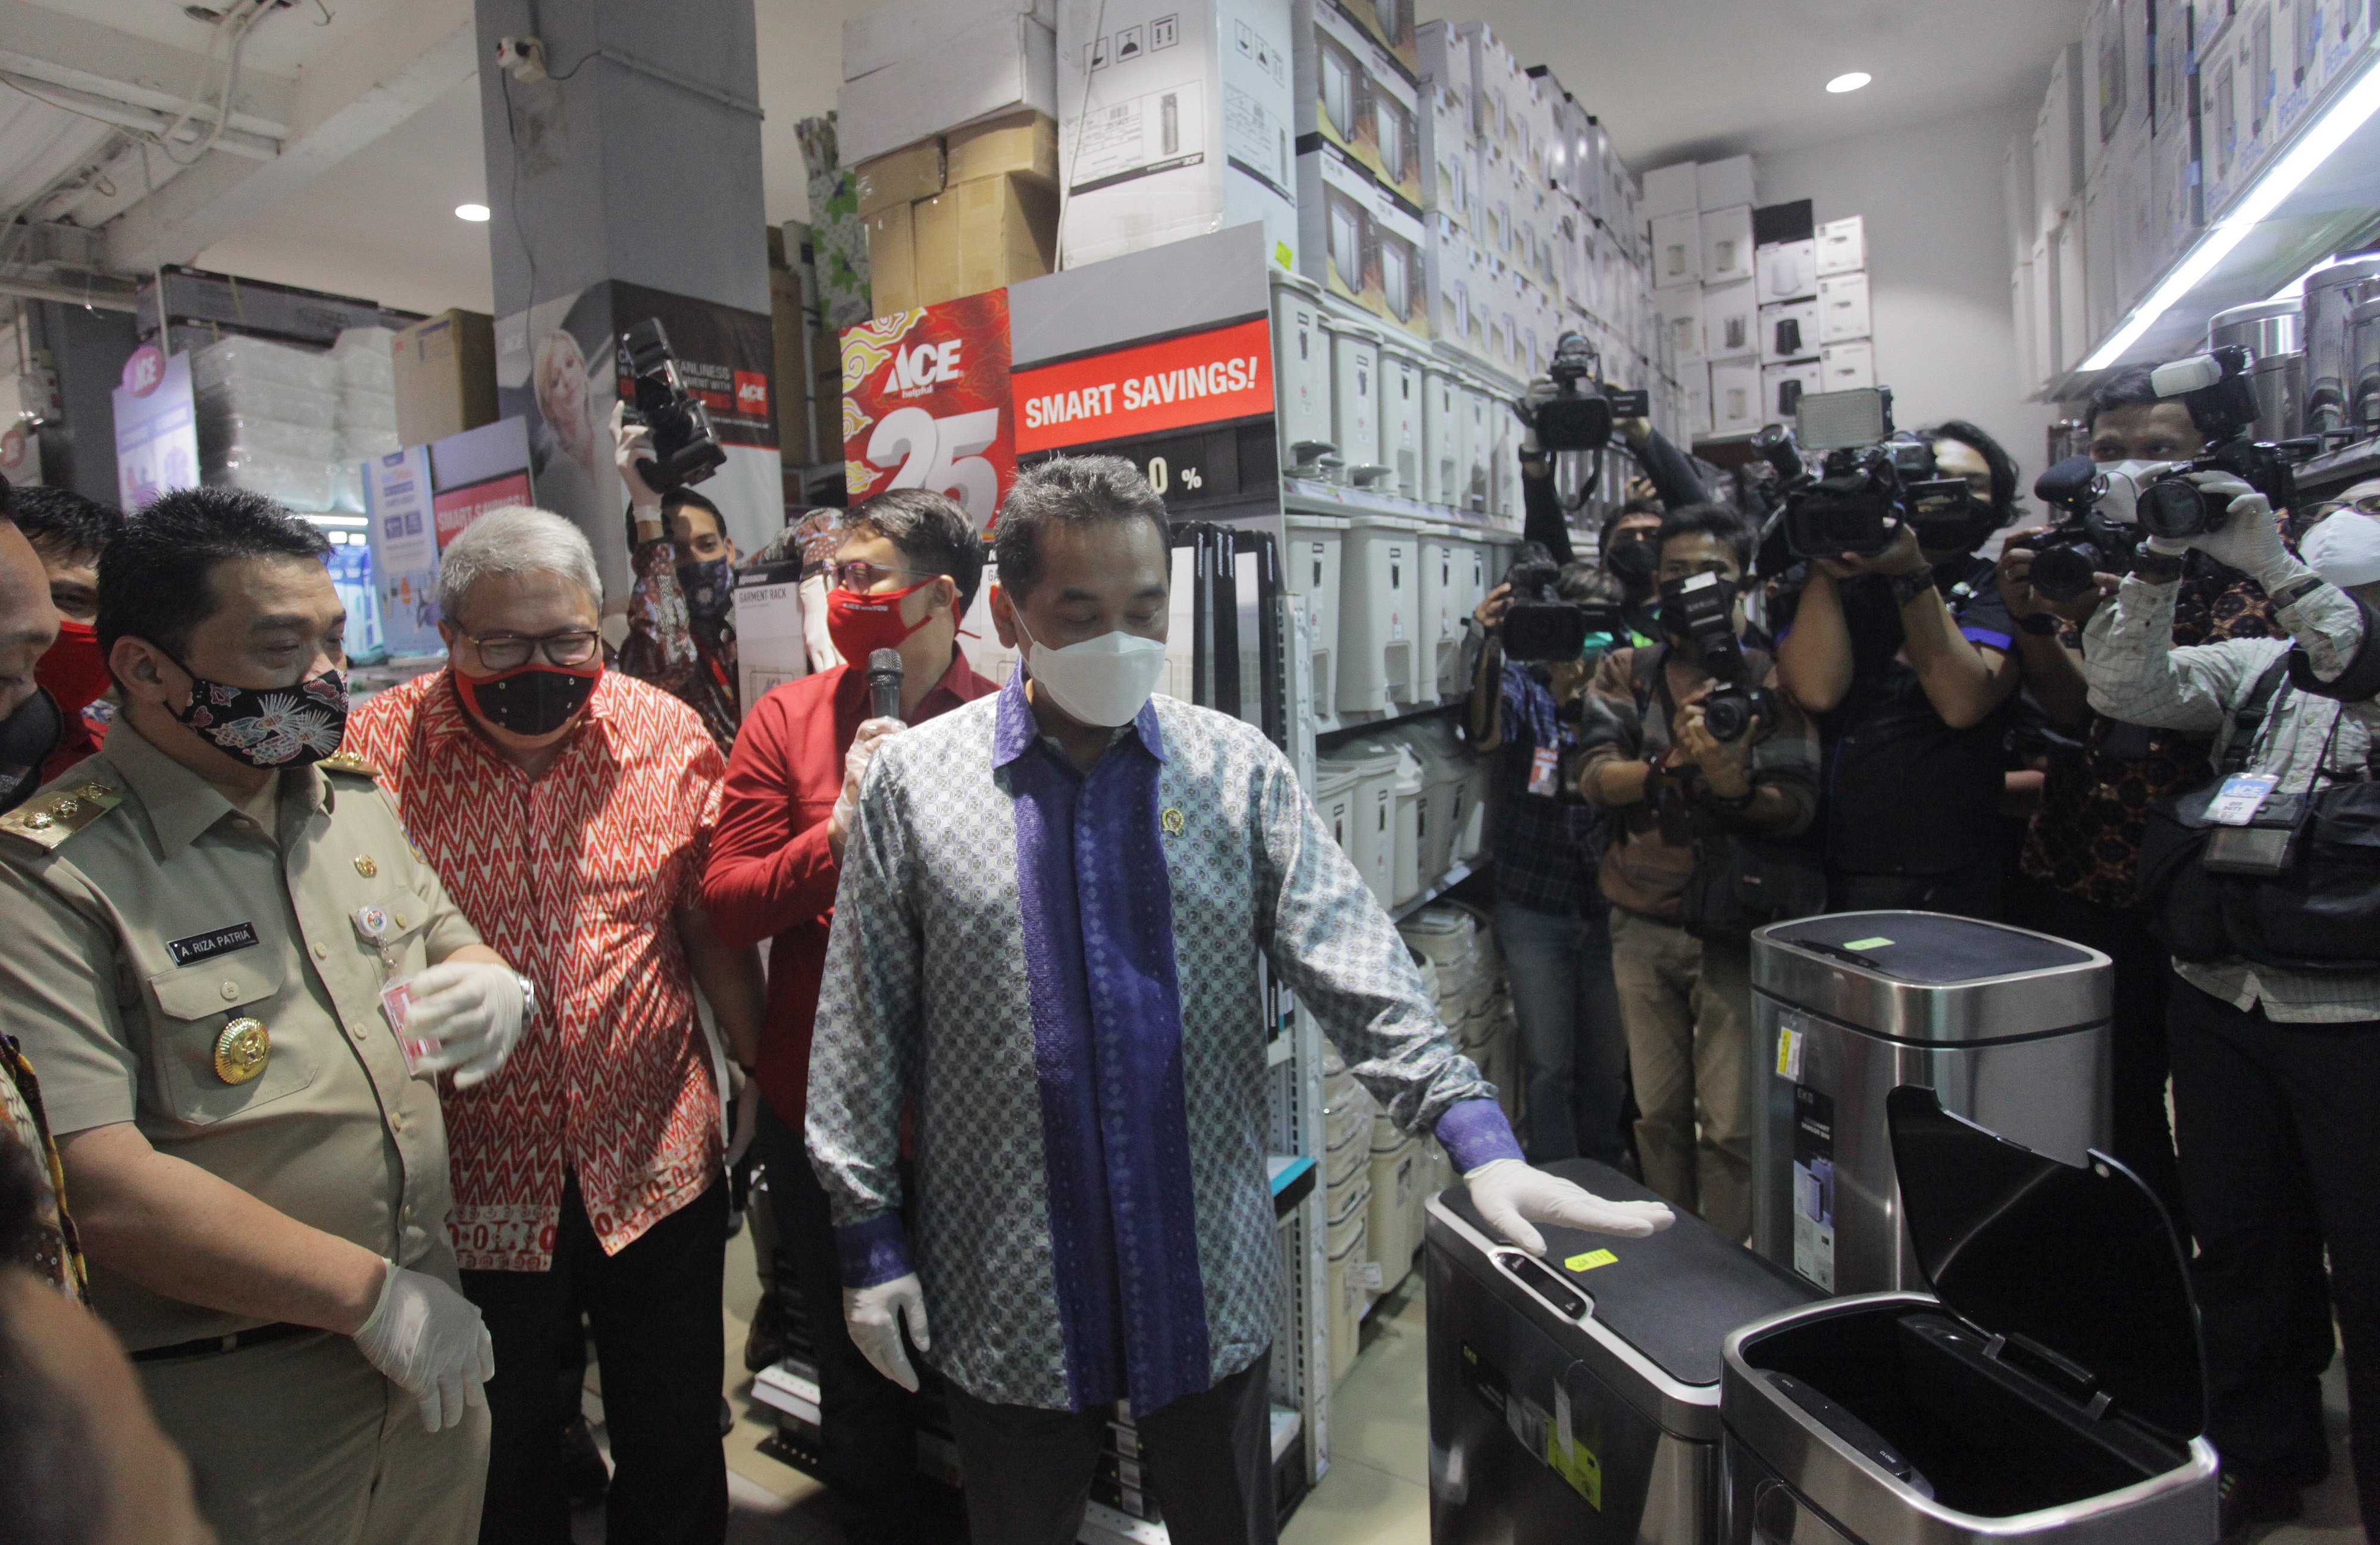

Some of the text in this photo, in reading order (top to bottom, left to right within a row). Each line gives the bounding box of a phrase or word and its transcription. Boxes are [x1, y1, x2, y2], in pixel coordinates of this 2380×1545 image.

[883, 339, 962, 394] ACE
[738, 383, 765, 401] ACE
[902, 384, 933, 399] helpful
[1025, 356, 1257, 429] SMART SAVINGS!
[1148, 456, 1202, 495] 0 %
[739, 587, 787, 603] GARMENT RACK
[181, 930, 250, 957] A. RIZA PATRIA
[1880, 1450, 1896, 1463] CLOSE
